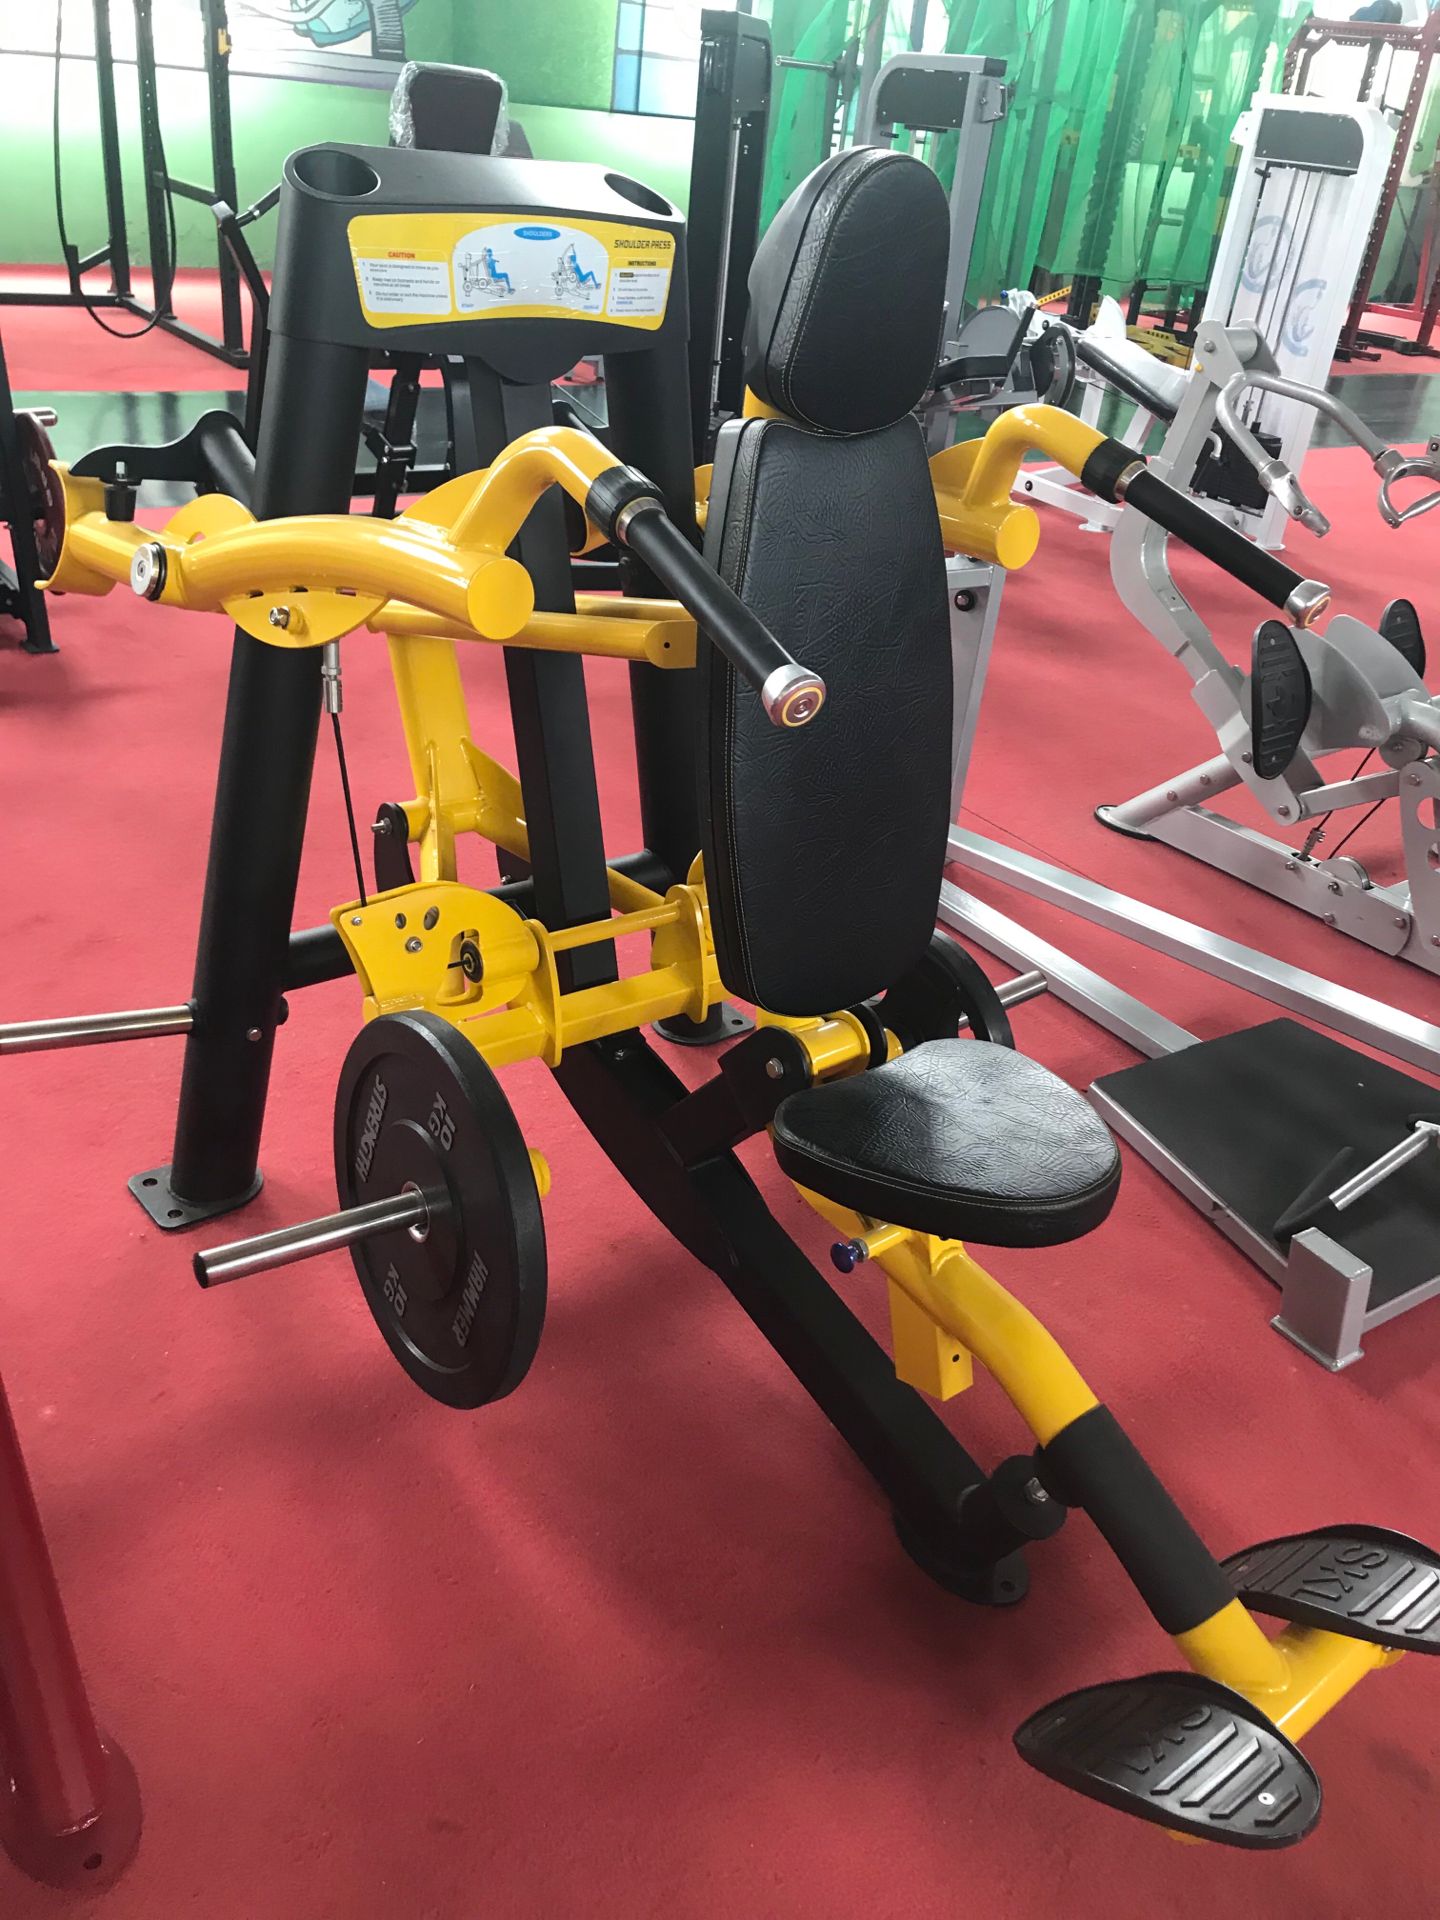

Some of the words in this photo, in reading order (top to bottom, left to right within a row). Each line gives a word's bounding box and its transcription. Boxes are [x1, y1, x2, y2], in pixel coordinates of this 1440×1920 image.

[387, 251, 416, 259] CAUTION
[613, 239, 651, 249] SHOULDER
[651, 240, 672, 250] PRESS
[354, 1073, 389, 1183] STRENGTH
[427, 1091, 448, 1137] KG
[440, 1112, 457, 1151] 10
[383, 1261, 400, 1303] KG
[394, 1283, 408, 1317] 10
[451, 1249, 489, 1348] HAMMER
